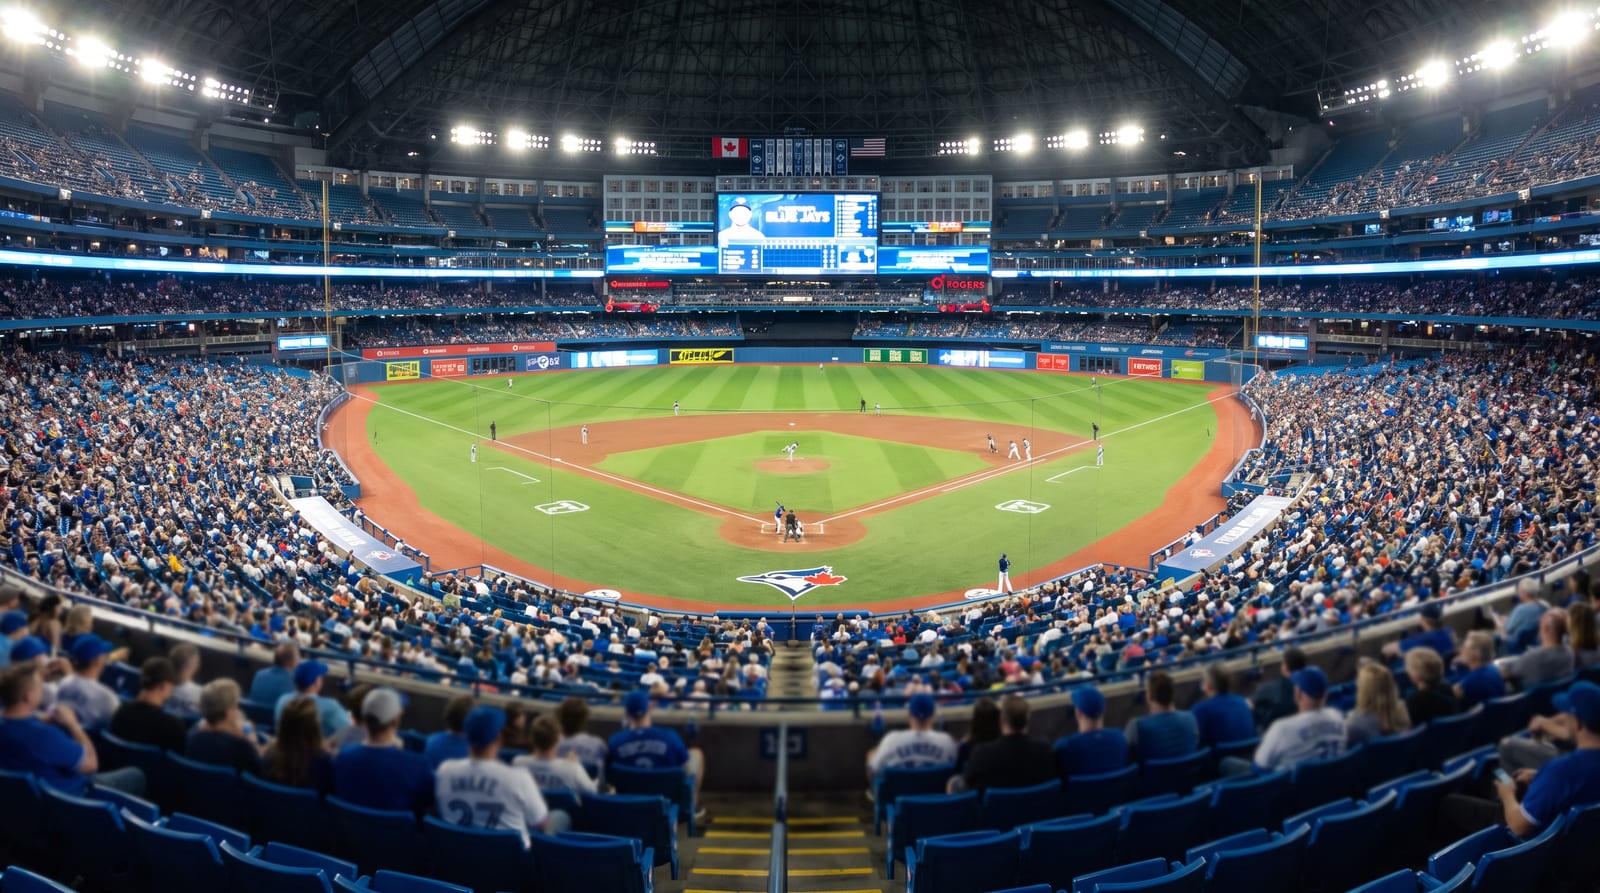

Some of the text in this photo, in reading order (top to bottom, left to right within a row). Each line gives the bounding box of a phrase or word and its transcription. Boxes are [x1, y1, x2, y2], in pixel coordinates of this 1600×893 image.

[765, 211, 831, 223] BLUE JAYS
[946, 280, 985, 289] ROGERS
